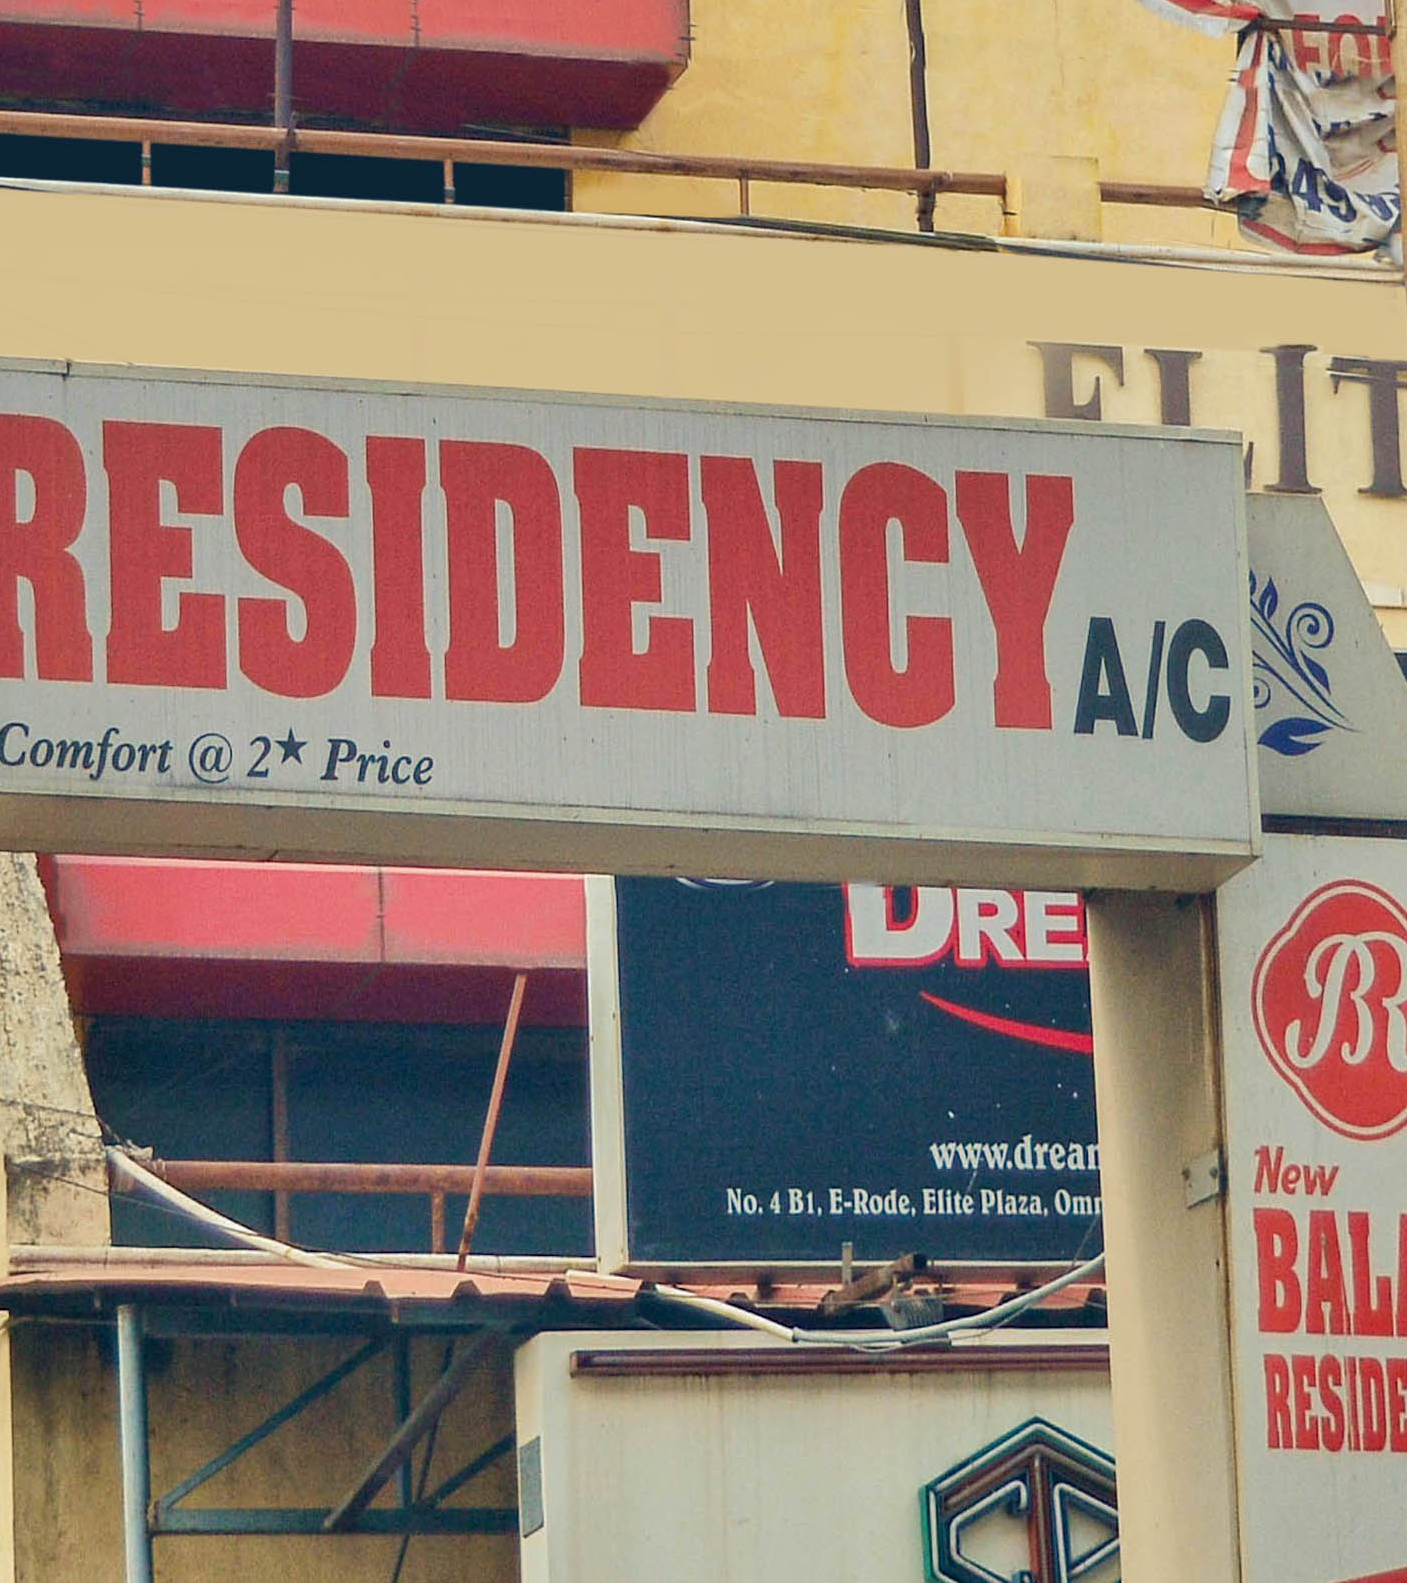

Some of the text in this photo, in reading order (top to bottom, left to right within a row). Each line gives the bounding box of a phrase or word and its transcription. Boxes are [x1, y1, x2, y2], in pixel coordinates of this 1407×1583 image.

[1072, 615, 1232, 743] A/C
[187, 732, 234, 785] @
[319, 737, 435, 786] Price
[1253, 1144, 1339, 1198] New
[726, 1187, 764, 1215] No.
[769, 1188, 782, 1215] 4
[828, 1187, 916, 1217] E-Rode,
[922, 1187, 975, 1215] Elite
[980, 1188, 1048, 1217] Plaza,
